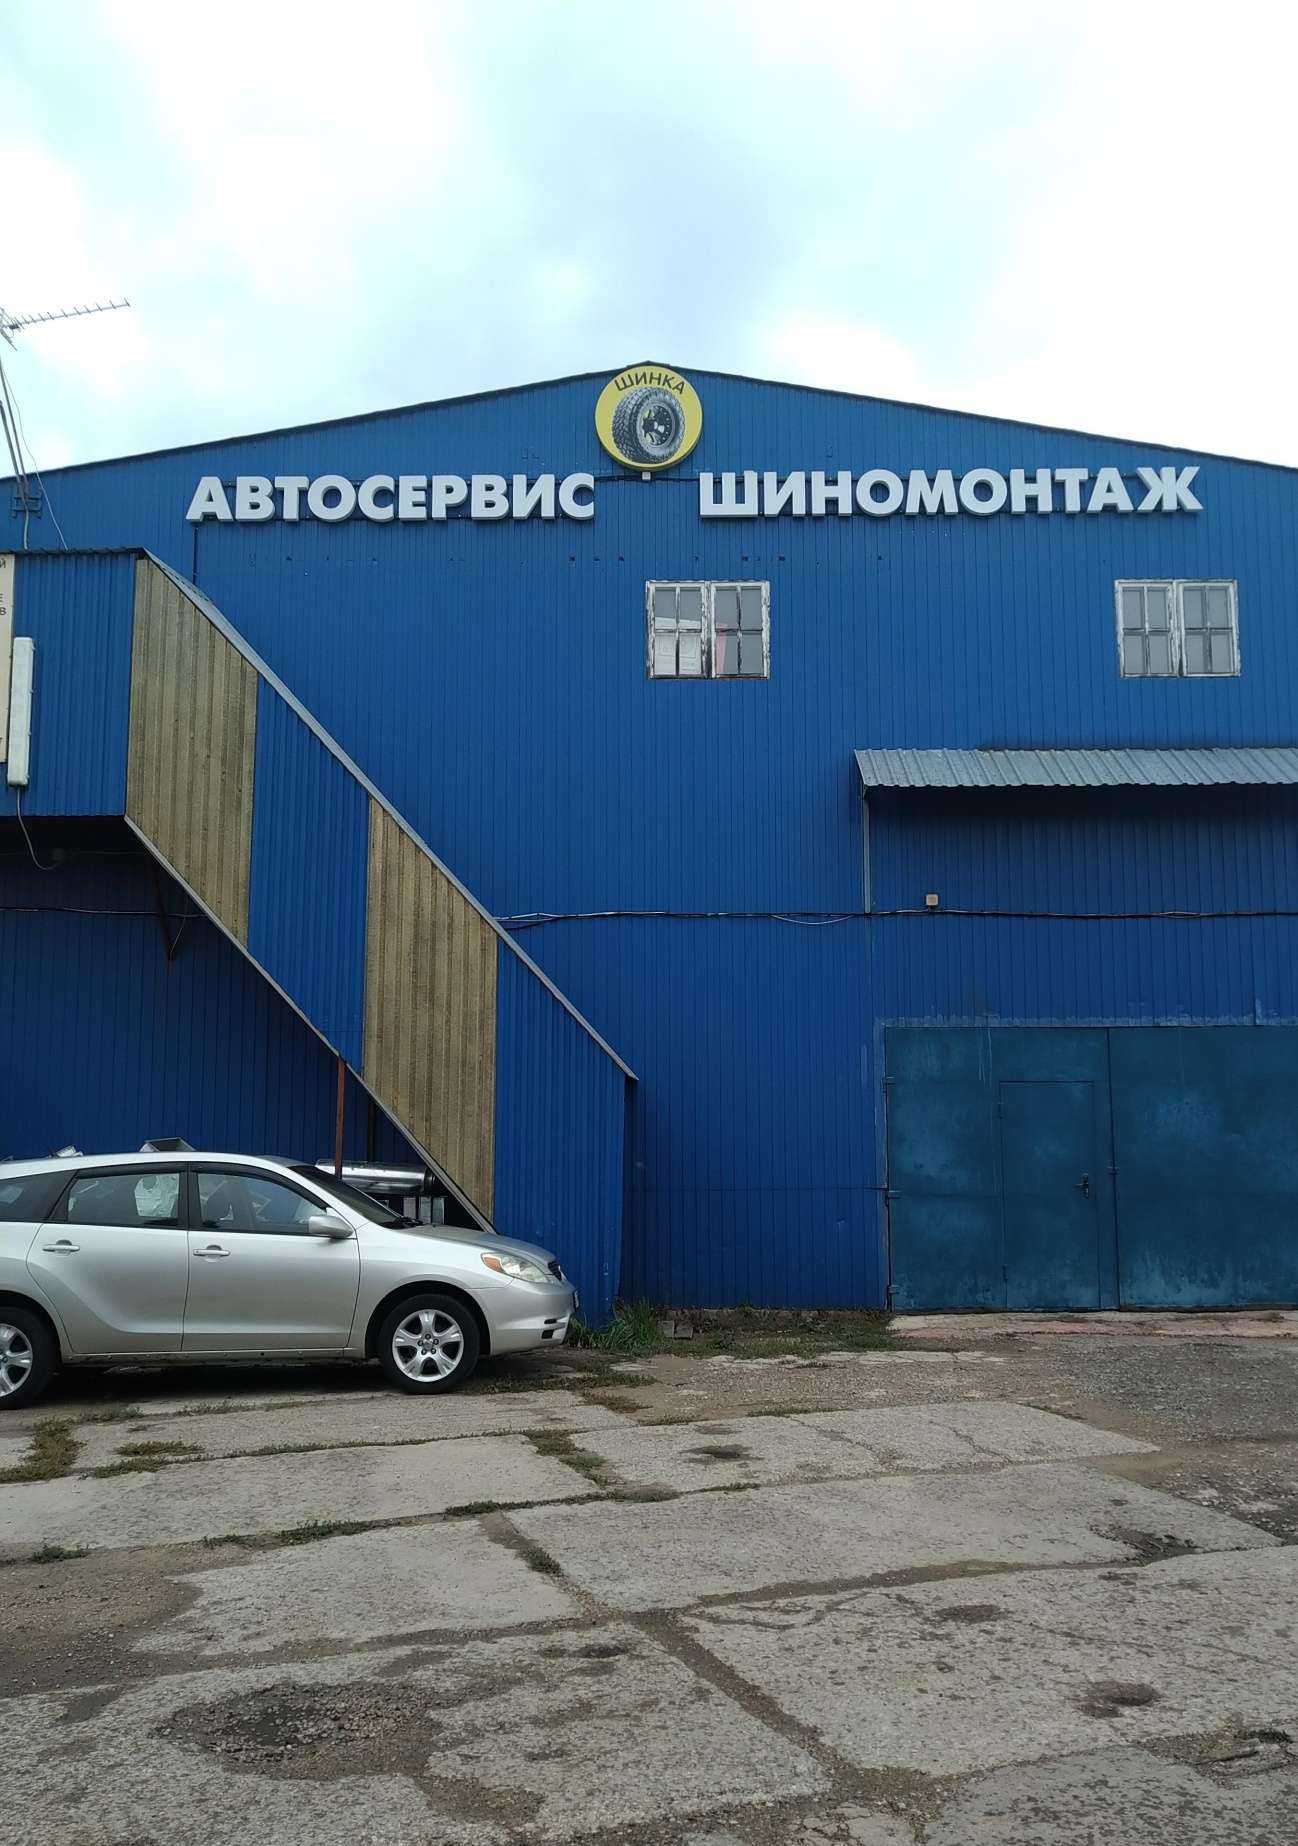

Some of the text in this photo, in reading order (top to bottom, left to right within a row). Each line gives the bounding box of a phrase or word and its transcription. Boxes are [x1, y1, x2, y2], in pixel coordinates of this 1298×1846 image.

[614, 371, 686, 395] ШИНКА
[185, 472, 595, 523] АВТОСЕРВИС
[699, 466, 1204, 518] ШИНОМОНТАЖ
